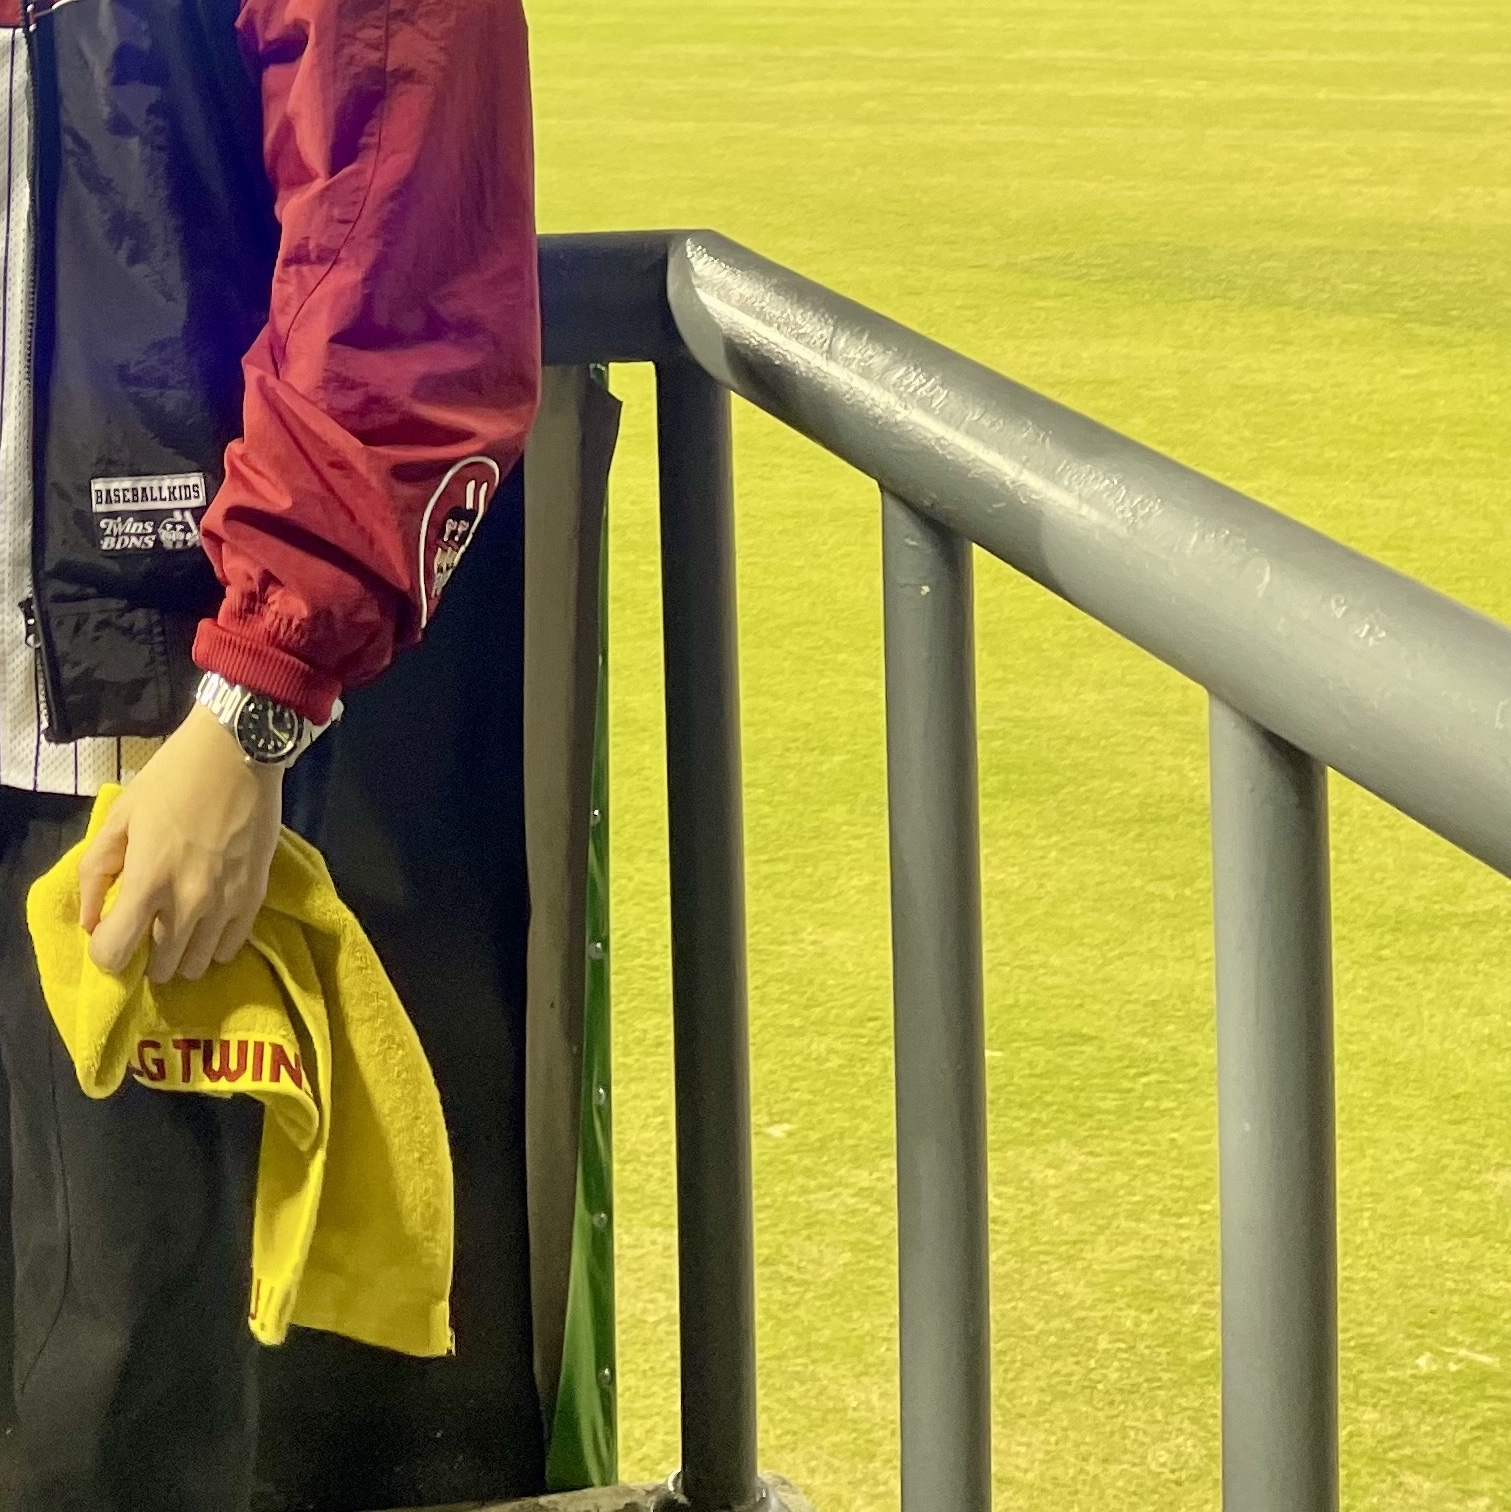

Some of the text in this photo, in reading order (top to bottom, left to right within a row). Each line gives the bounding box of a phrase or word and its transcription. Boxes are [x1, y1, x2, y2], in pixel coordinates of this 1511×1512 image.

[94, 484, 201, 505] BASEBALLKIDS
[99, 516, 154, 537] Twins
[129, 1038, 304, 1089] G TWIN
